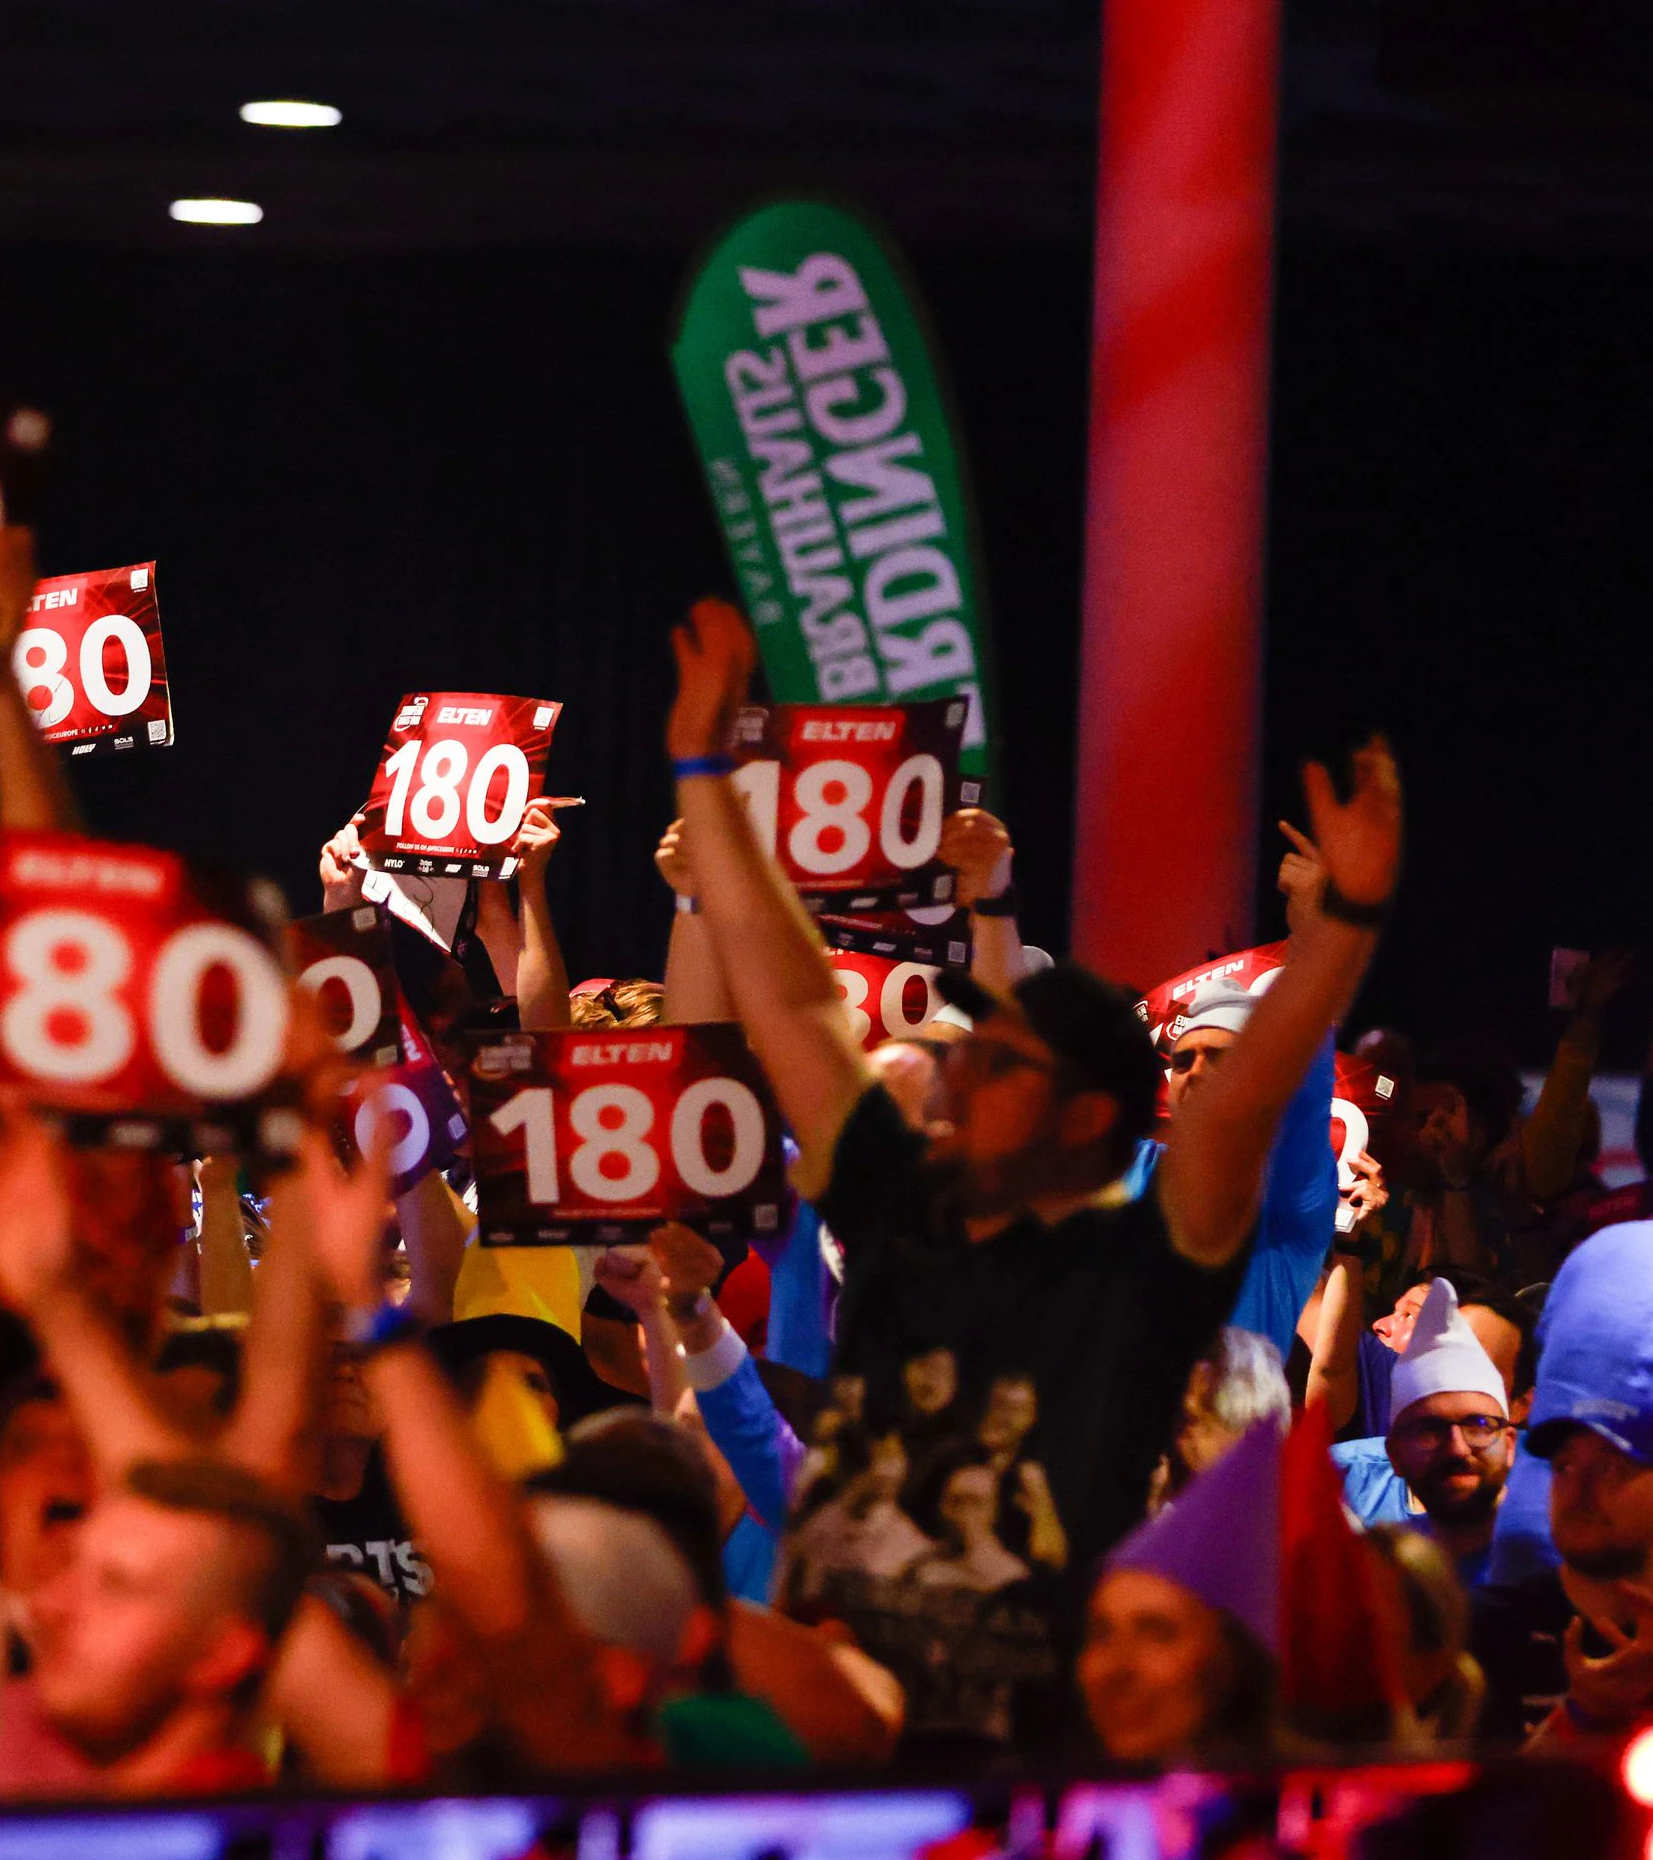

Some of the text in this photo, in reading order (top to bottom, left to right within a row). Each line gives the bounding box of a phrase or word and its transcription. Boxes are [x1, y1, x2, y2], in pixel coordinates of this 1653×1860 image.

[27, 588, 78, 612] TEN
[437, 706, 493, 727] ELTEN
[801, 720, 897, 742] ELTEN
[384, 738, 530, 845] 180
[729, 753, 945, 876] 180
[384, 858, 404, 868] HYLO
[1172, 959, 1245, 1001] ELTEN
[570, 1042, 675, 1067] ELTEN
[489, 1076, 766, 1205] 180
